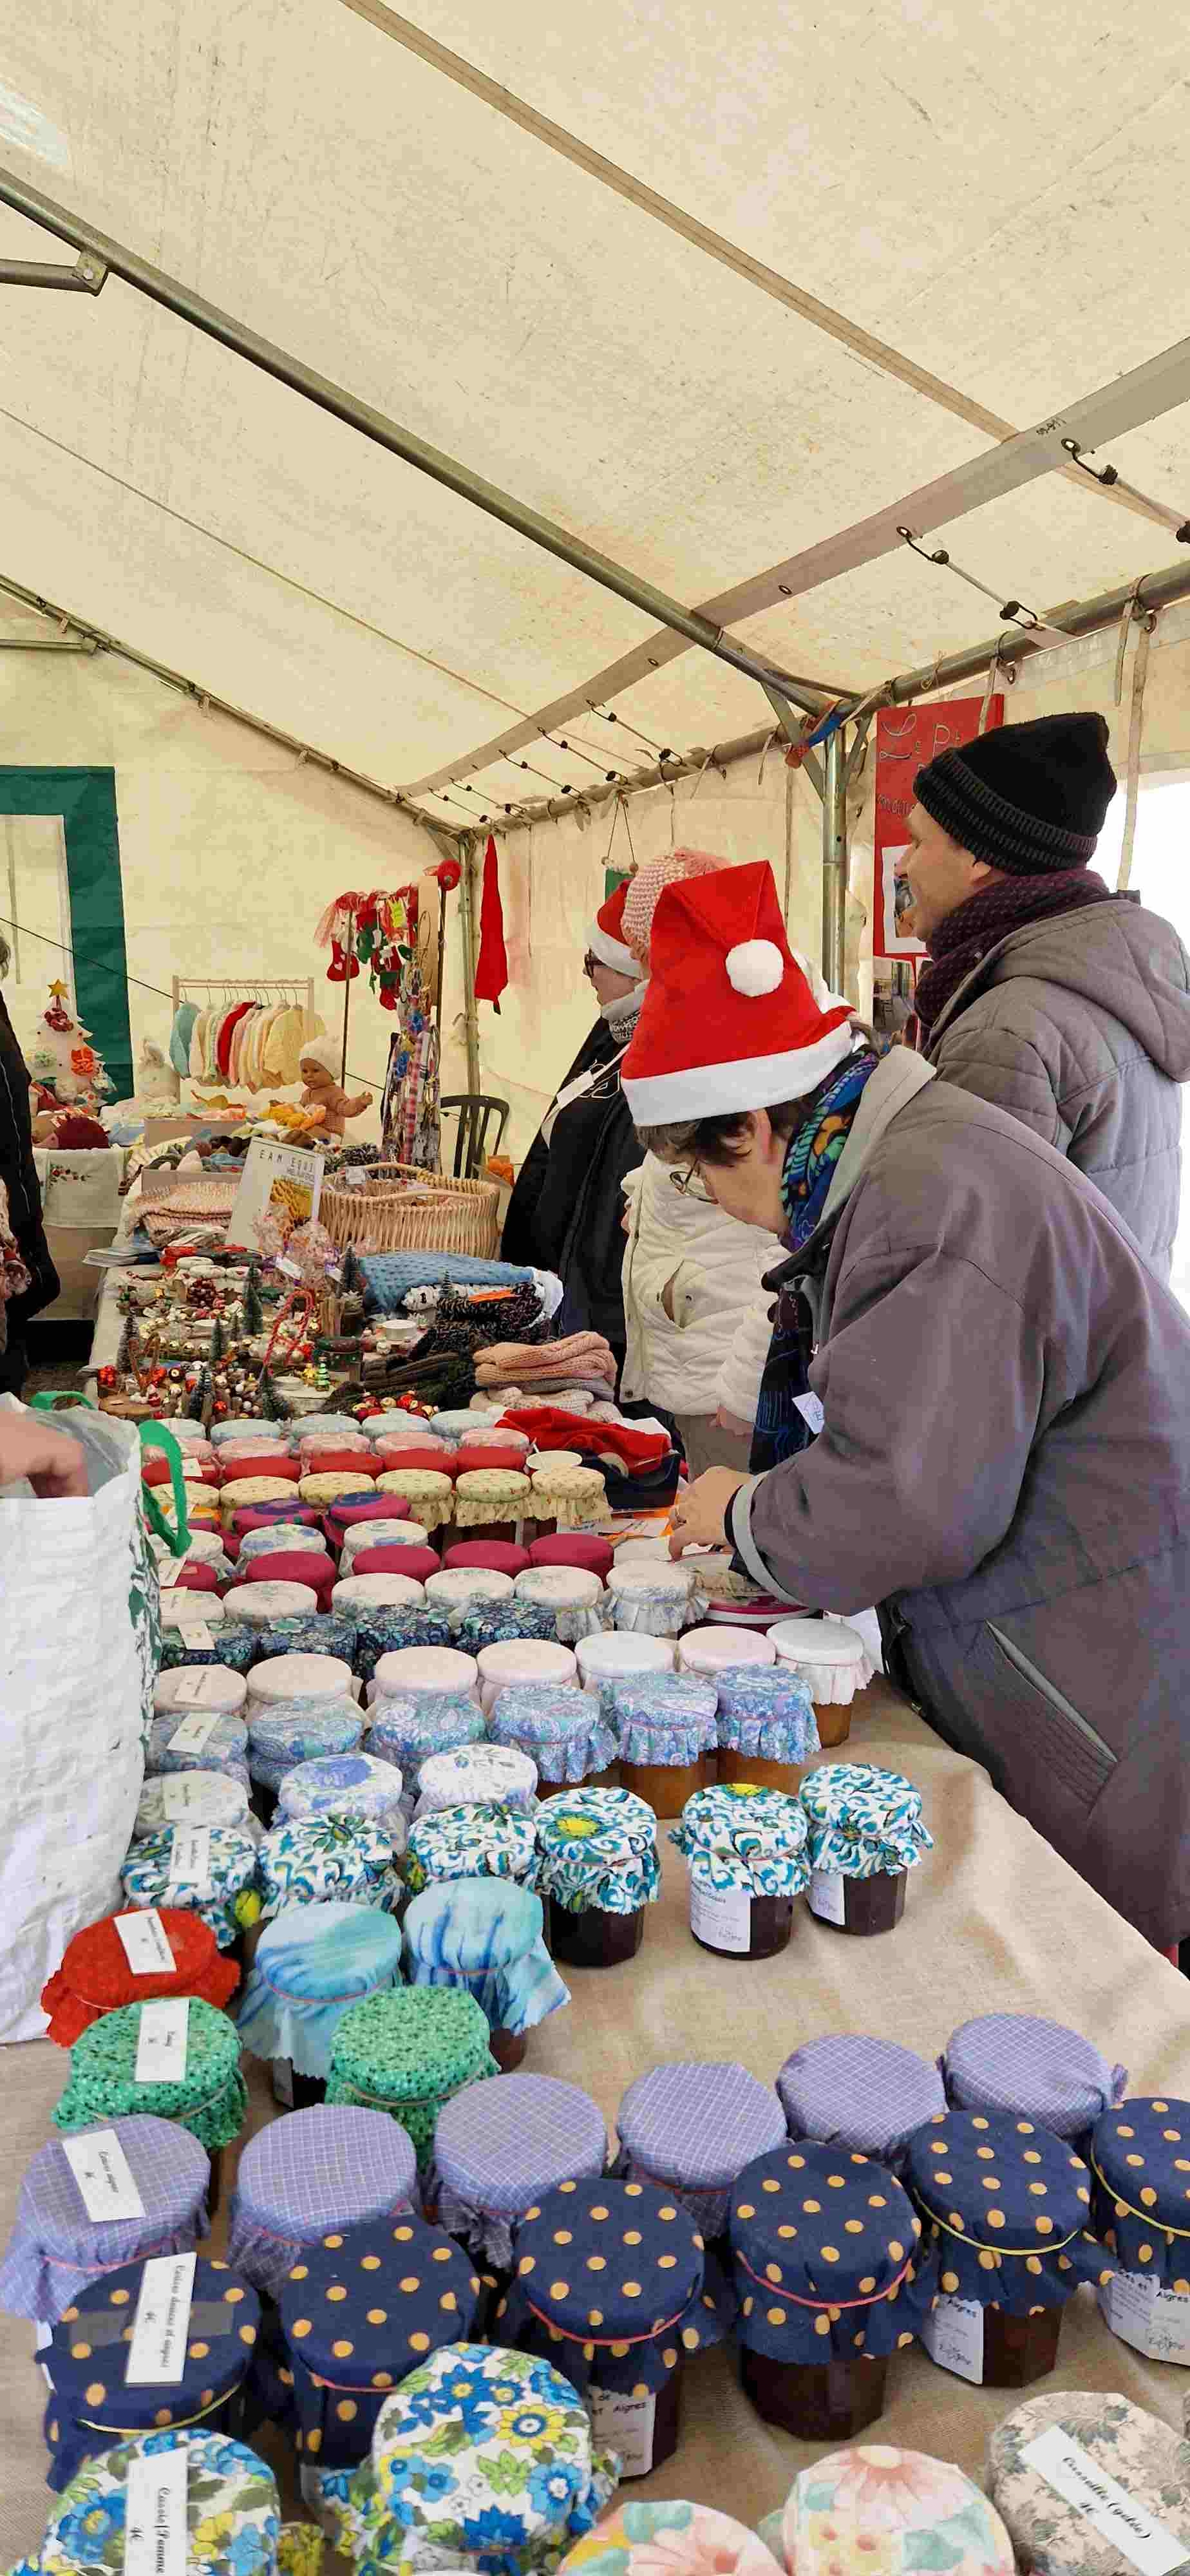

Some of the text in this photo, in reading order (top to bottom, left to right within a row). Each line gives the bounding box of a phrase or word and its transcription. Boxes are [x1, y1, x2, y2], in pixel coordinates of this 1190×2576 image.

[171, 2264, 185, 2293] Cerises
[167, 2295, 181, 2326] douces
[159, 2339, 173, 2367] aigres
[613, 2401, 647, 2414] Aigres
